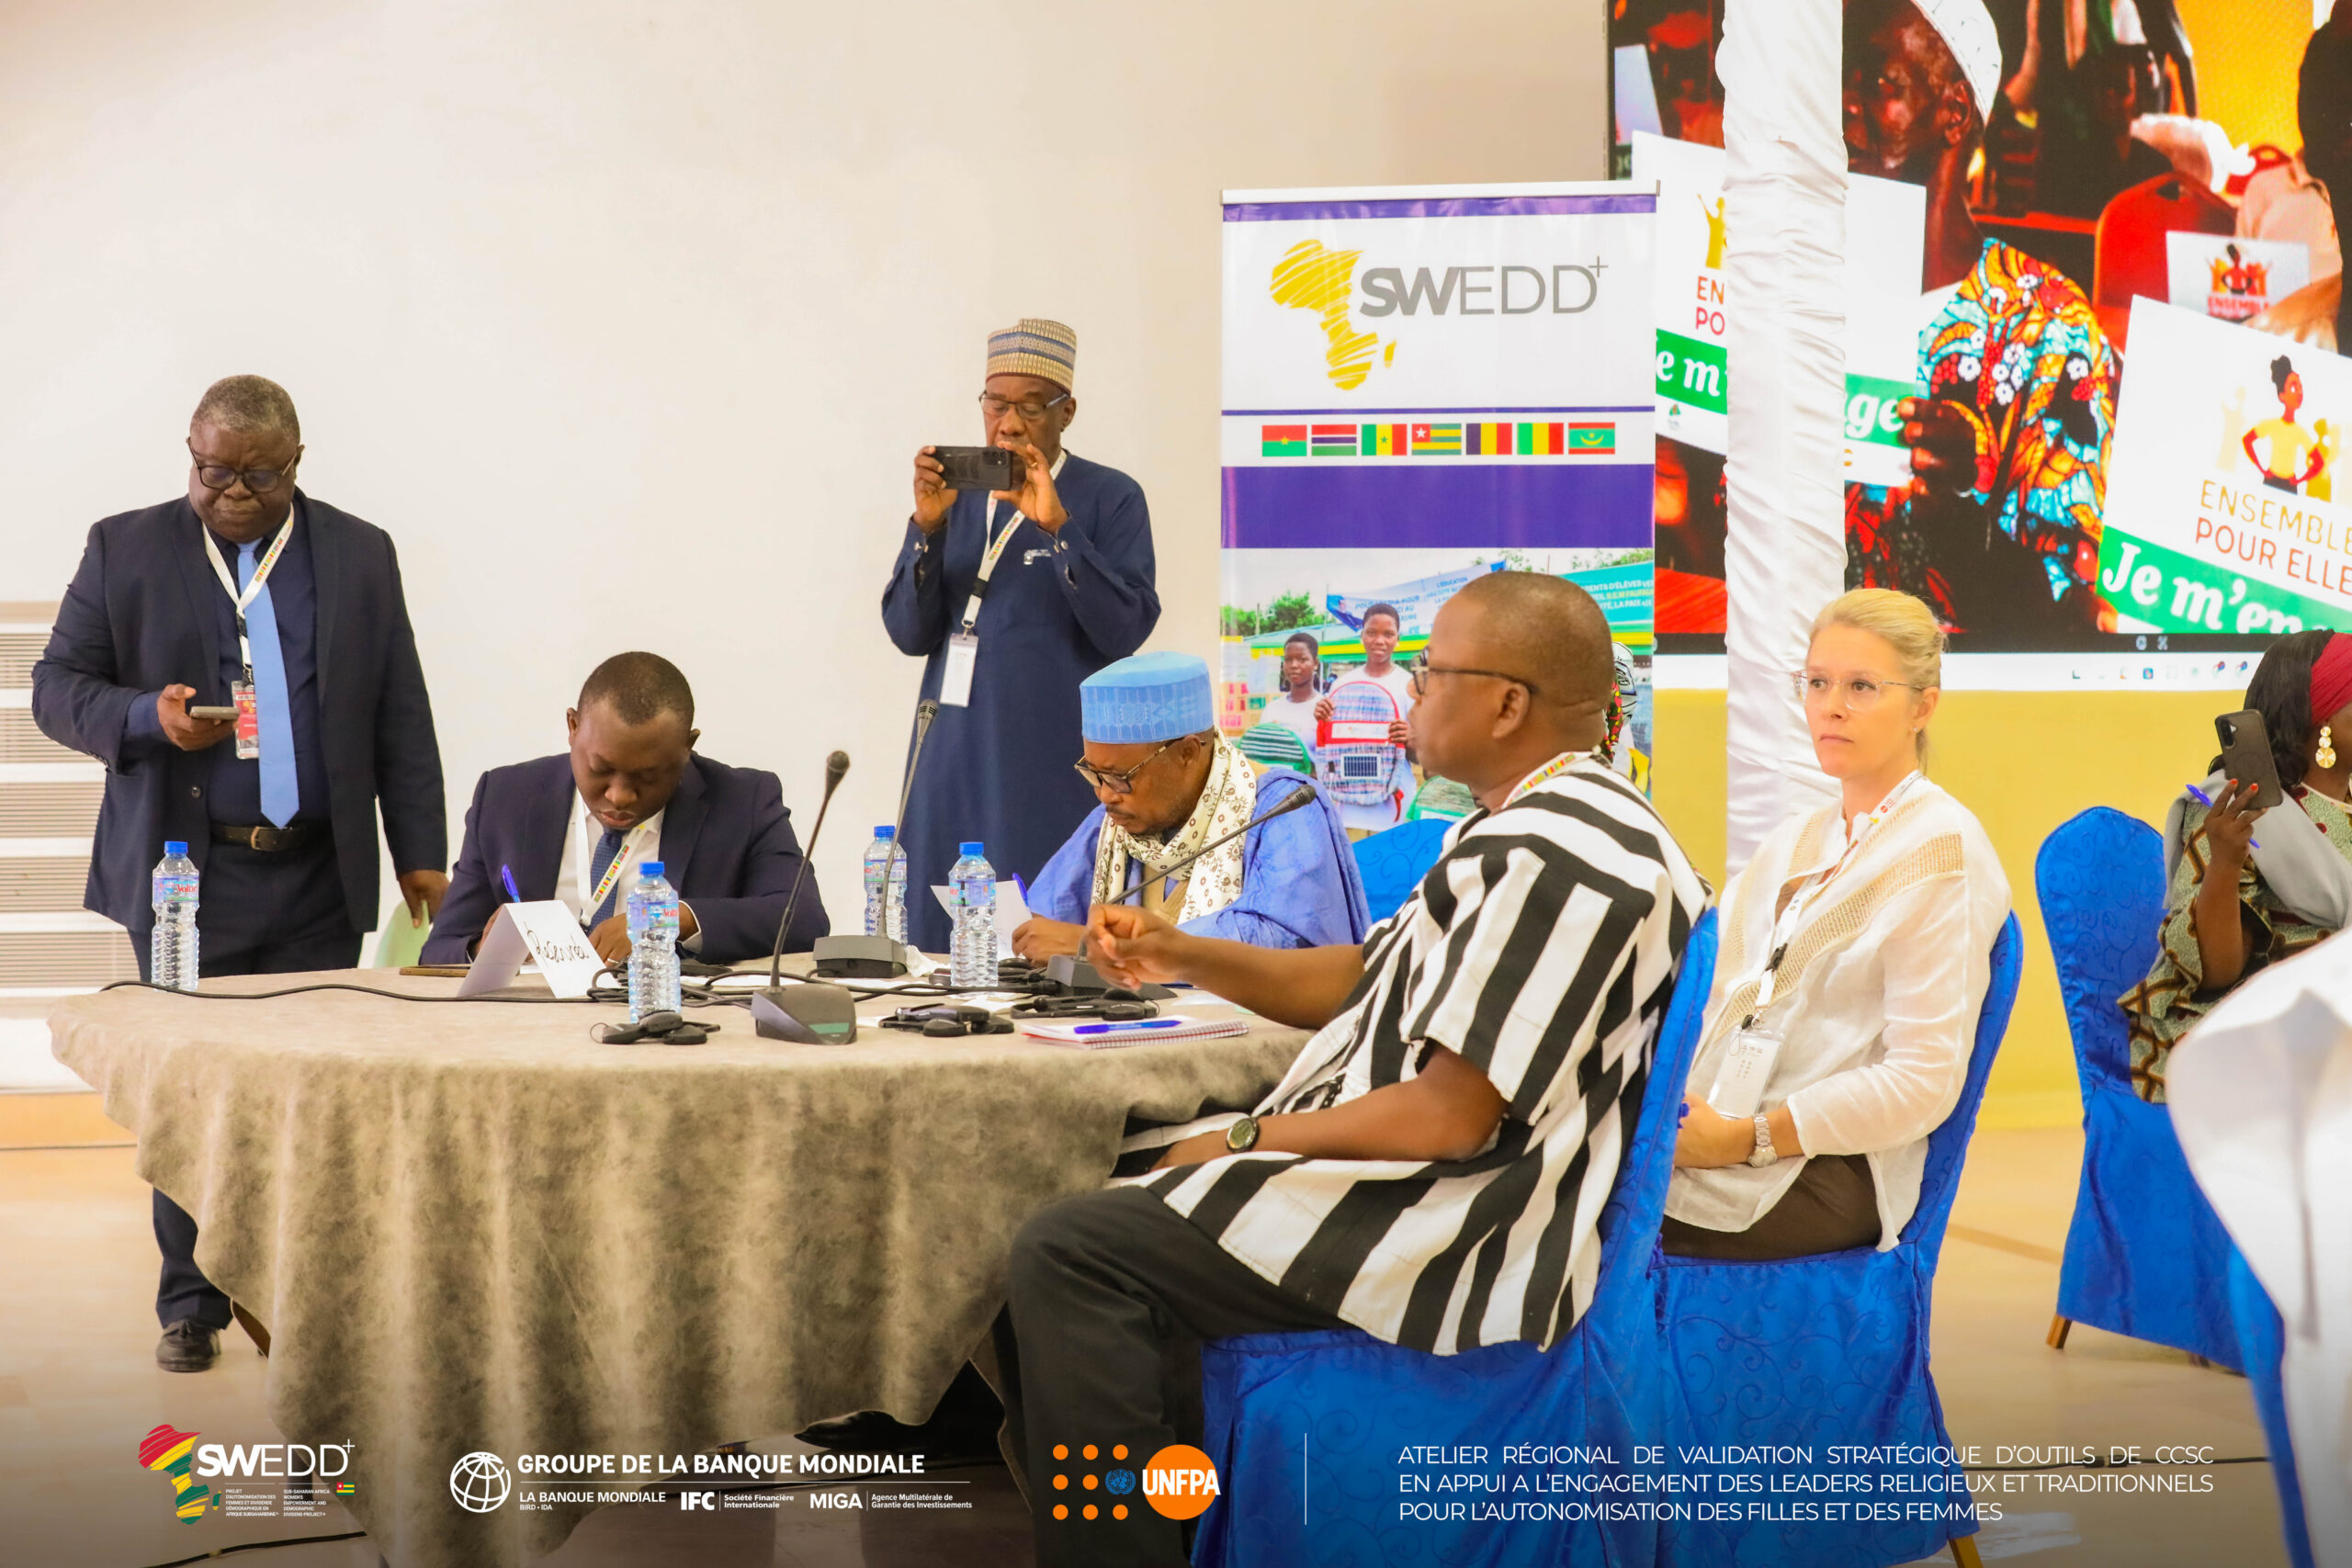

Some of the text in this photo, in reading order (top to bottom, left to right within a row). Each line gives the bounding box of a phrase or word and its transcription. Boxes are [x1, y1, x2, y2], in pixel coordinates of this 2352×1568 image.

[1696, 276, 1724, 305] EN
[1695, 306, 1725, 336] PO
[1845, 393, 1905, 439] ge
[2196, 517, 2352, 597] POUR ELLE
[2102, 541, 2306, 634] Je m'en
